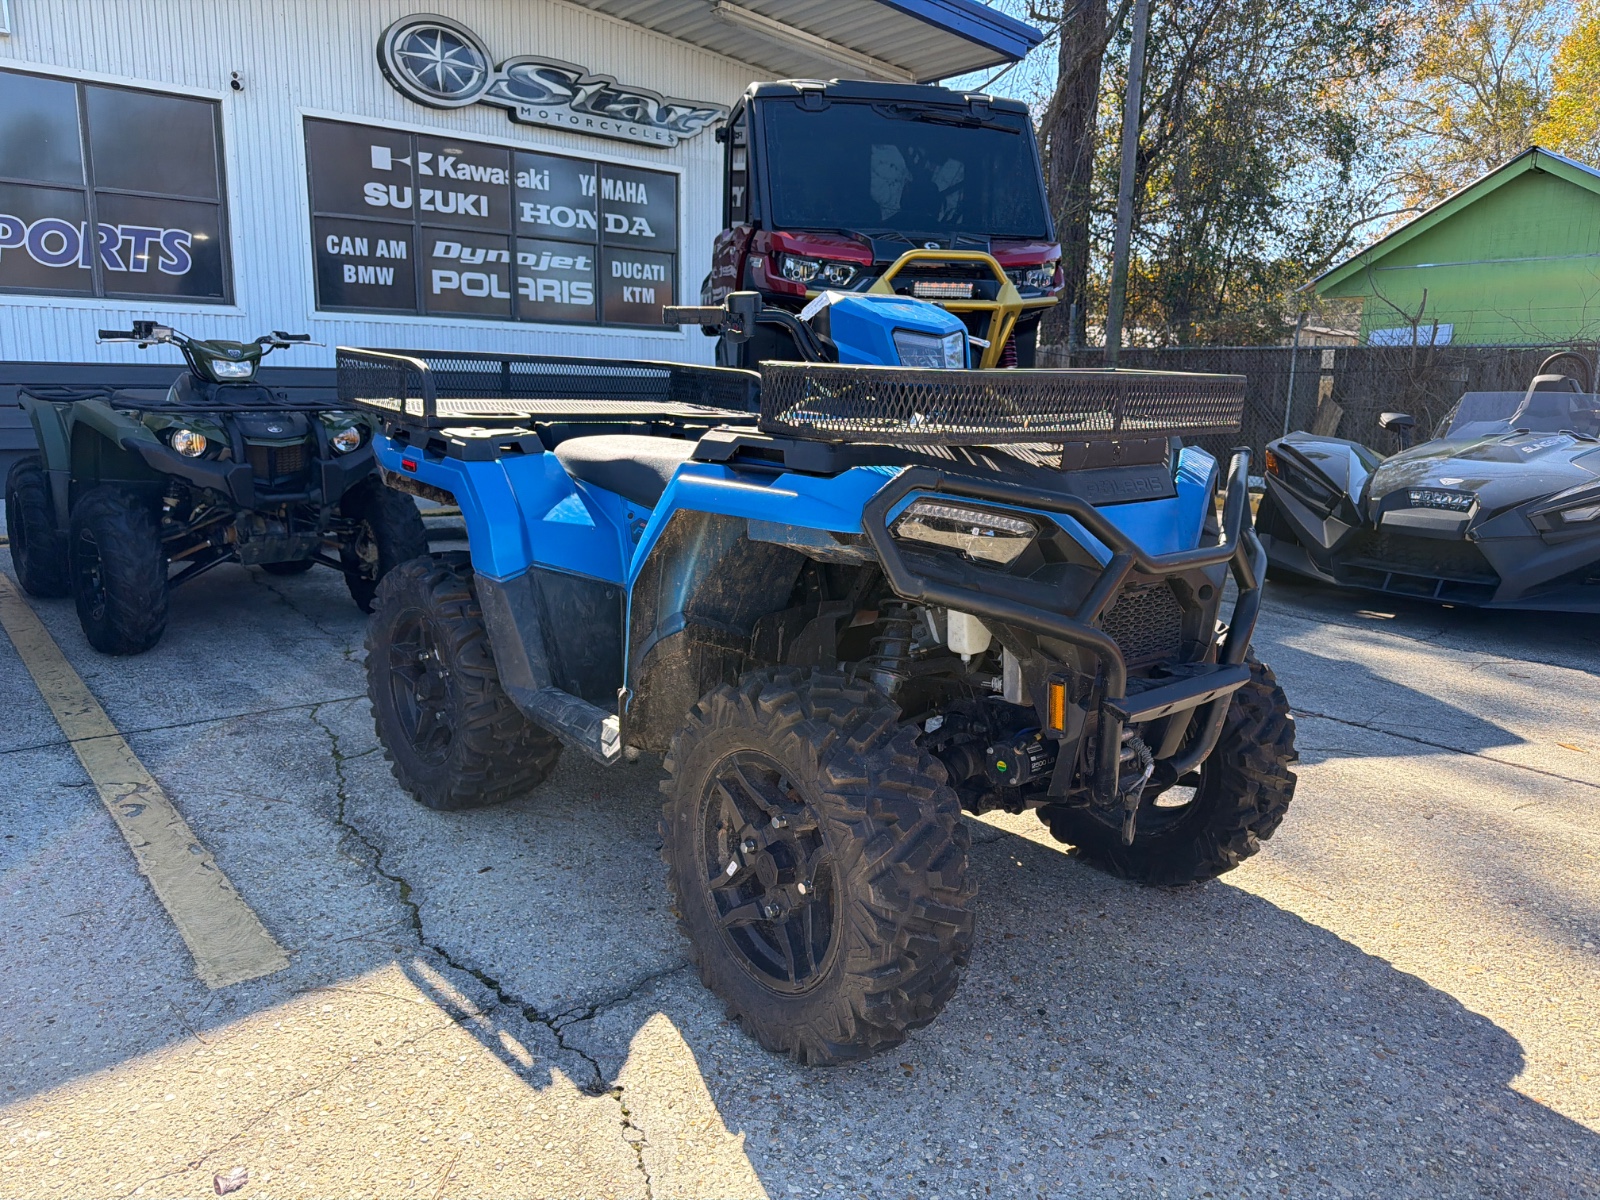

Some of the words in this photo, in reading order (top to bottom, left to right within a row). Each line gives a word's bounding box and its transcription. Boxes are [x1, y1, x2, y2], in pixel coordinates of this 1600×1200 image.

[484, 61, 723, 134] Star
[520, 105, 676, 143] MOTORCYCLES
[363, 182, 489, 217] SUZUKI
[579, 174, 648, 205] YAMAHA
[519, 202, 656, 237] HONDA
[326, 235, 369, 256] CAN
[375, 239, 407, 260] AM
[432, 241, 592, 271] Dynojet
[343, 264, 395, 286] BMW
[611, 260, 665, 281] DUCATI
[431, 269, 594, 305] POLARIS
[623, 286, 655, 304] KTM
